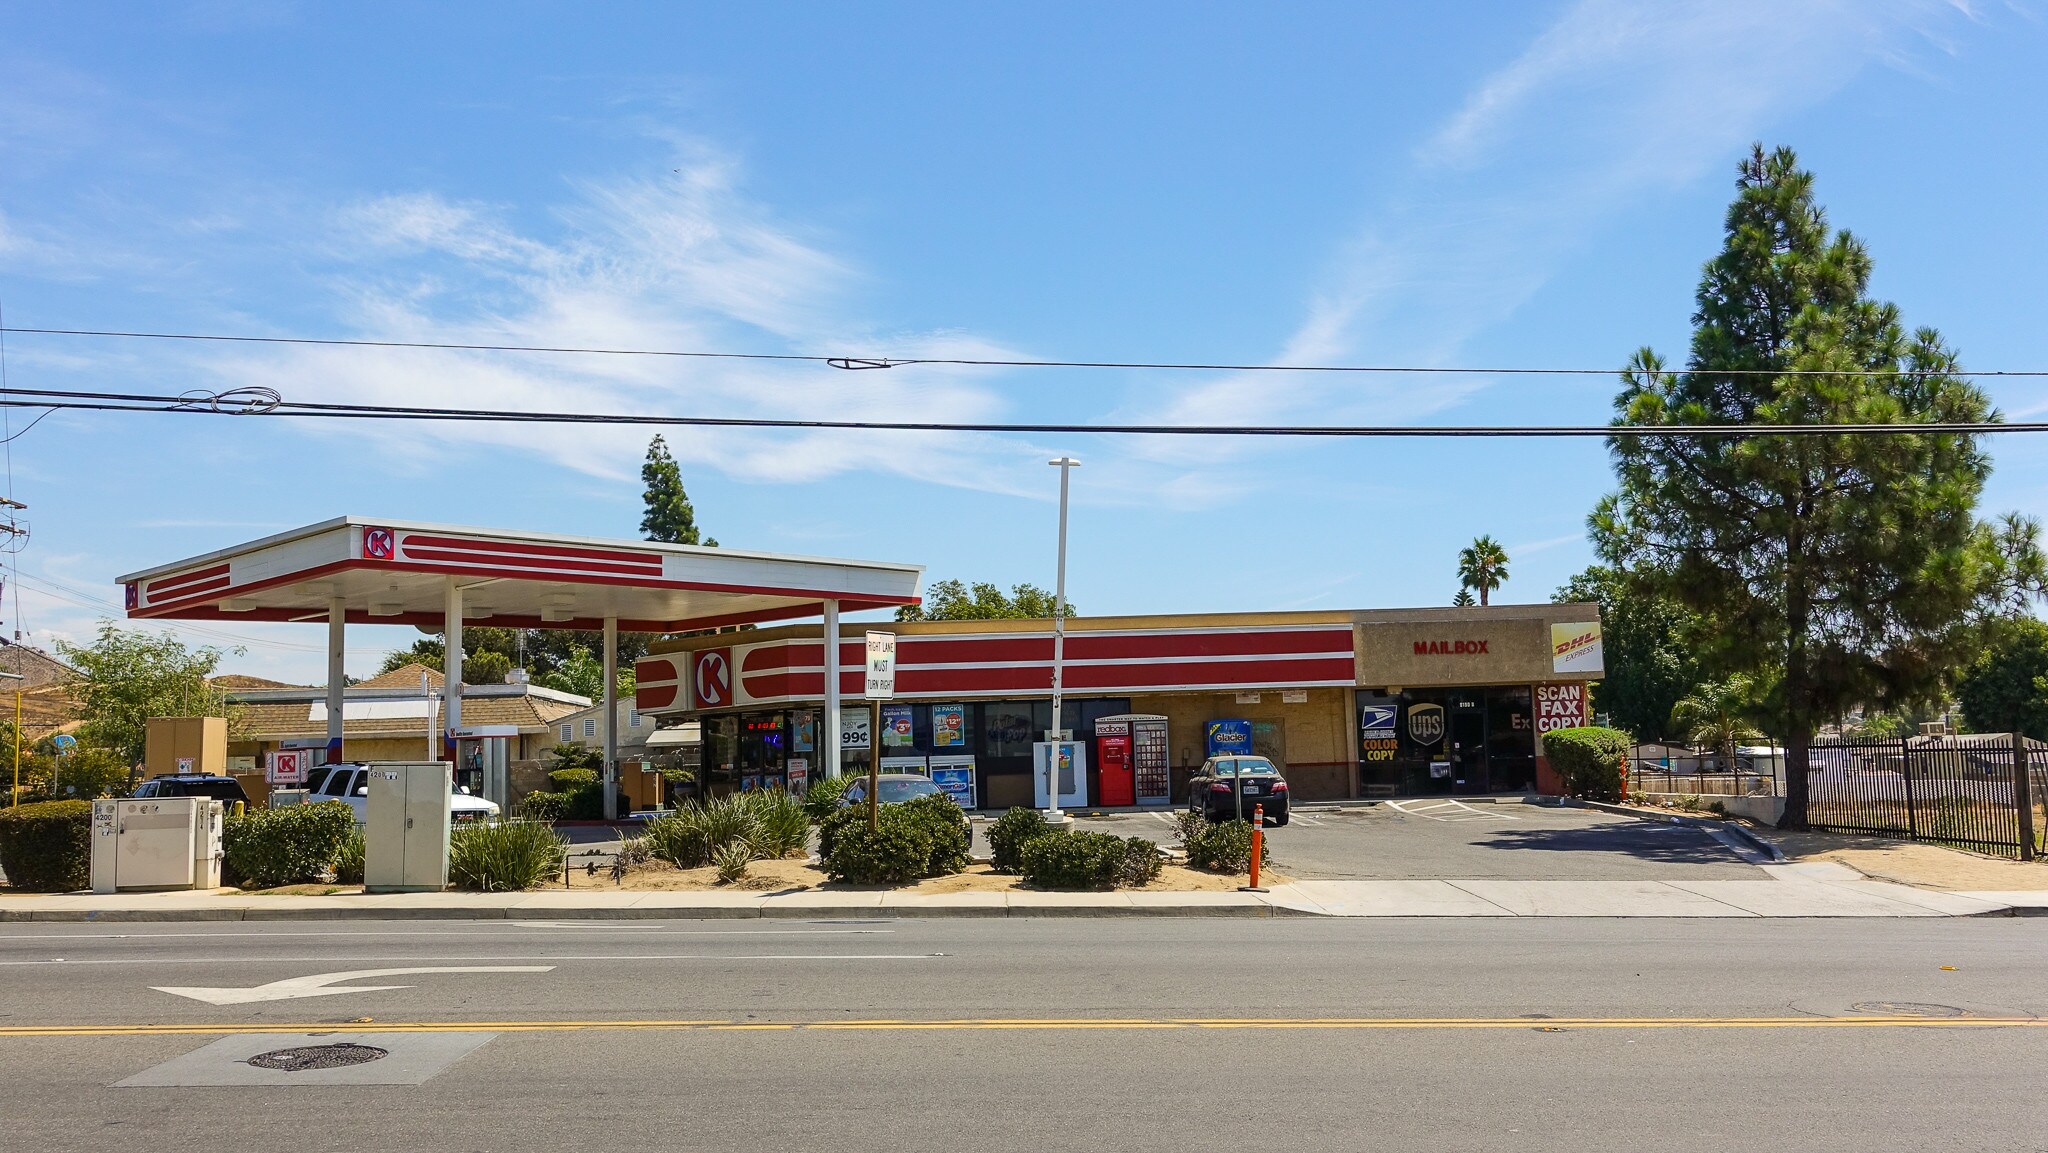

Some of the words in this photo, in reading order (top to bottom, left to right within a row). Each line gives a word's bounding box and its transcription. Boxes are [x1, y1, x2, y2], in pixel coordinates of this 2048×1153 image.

[868, 641, 880, 652] RIGHT
[882, 642, 894, 653] LANE
[1413, 640, 1489, 655] MAILBOX
[1555, 632, 1595, 655] DHL
[1565, 645, 1595, 663] EXPRESS
[873, 660, 888, 672] MUST
[699, 654, 730, 703] K
[867, 679, 879, 690] TURN
[880, 680, 893, 690] RIGHT
[1537, 685, 1580, 701] SCAN
[1540, 701, 1580, 716] FAX
[1412, 715, 1441, 737] ups
[1511, 713, 1531, 730] Ex
[1538, 717, 1583, 732] COPY
[842, 731, 868, 743] 99¢
[1215, 733, 1247, 742] Glacier
[1363, 739, 1398, 750] COLOR
[1367, 750, 1395, 761] COPY
